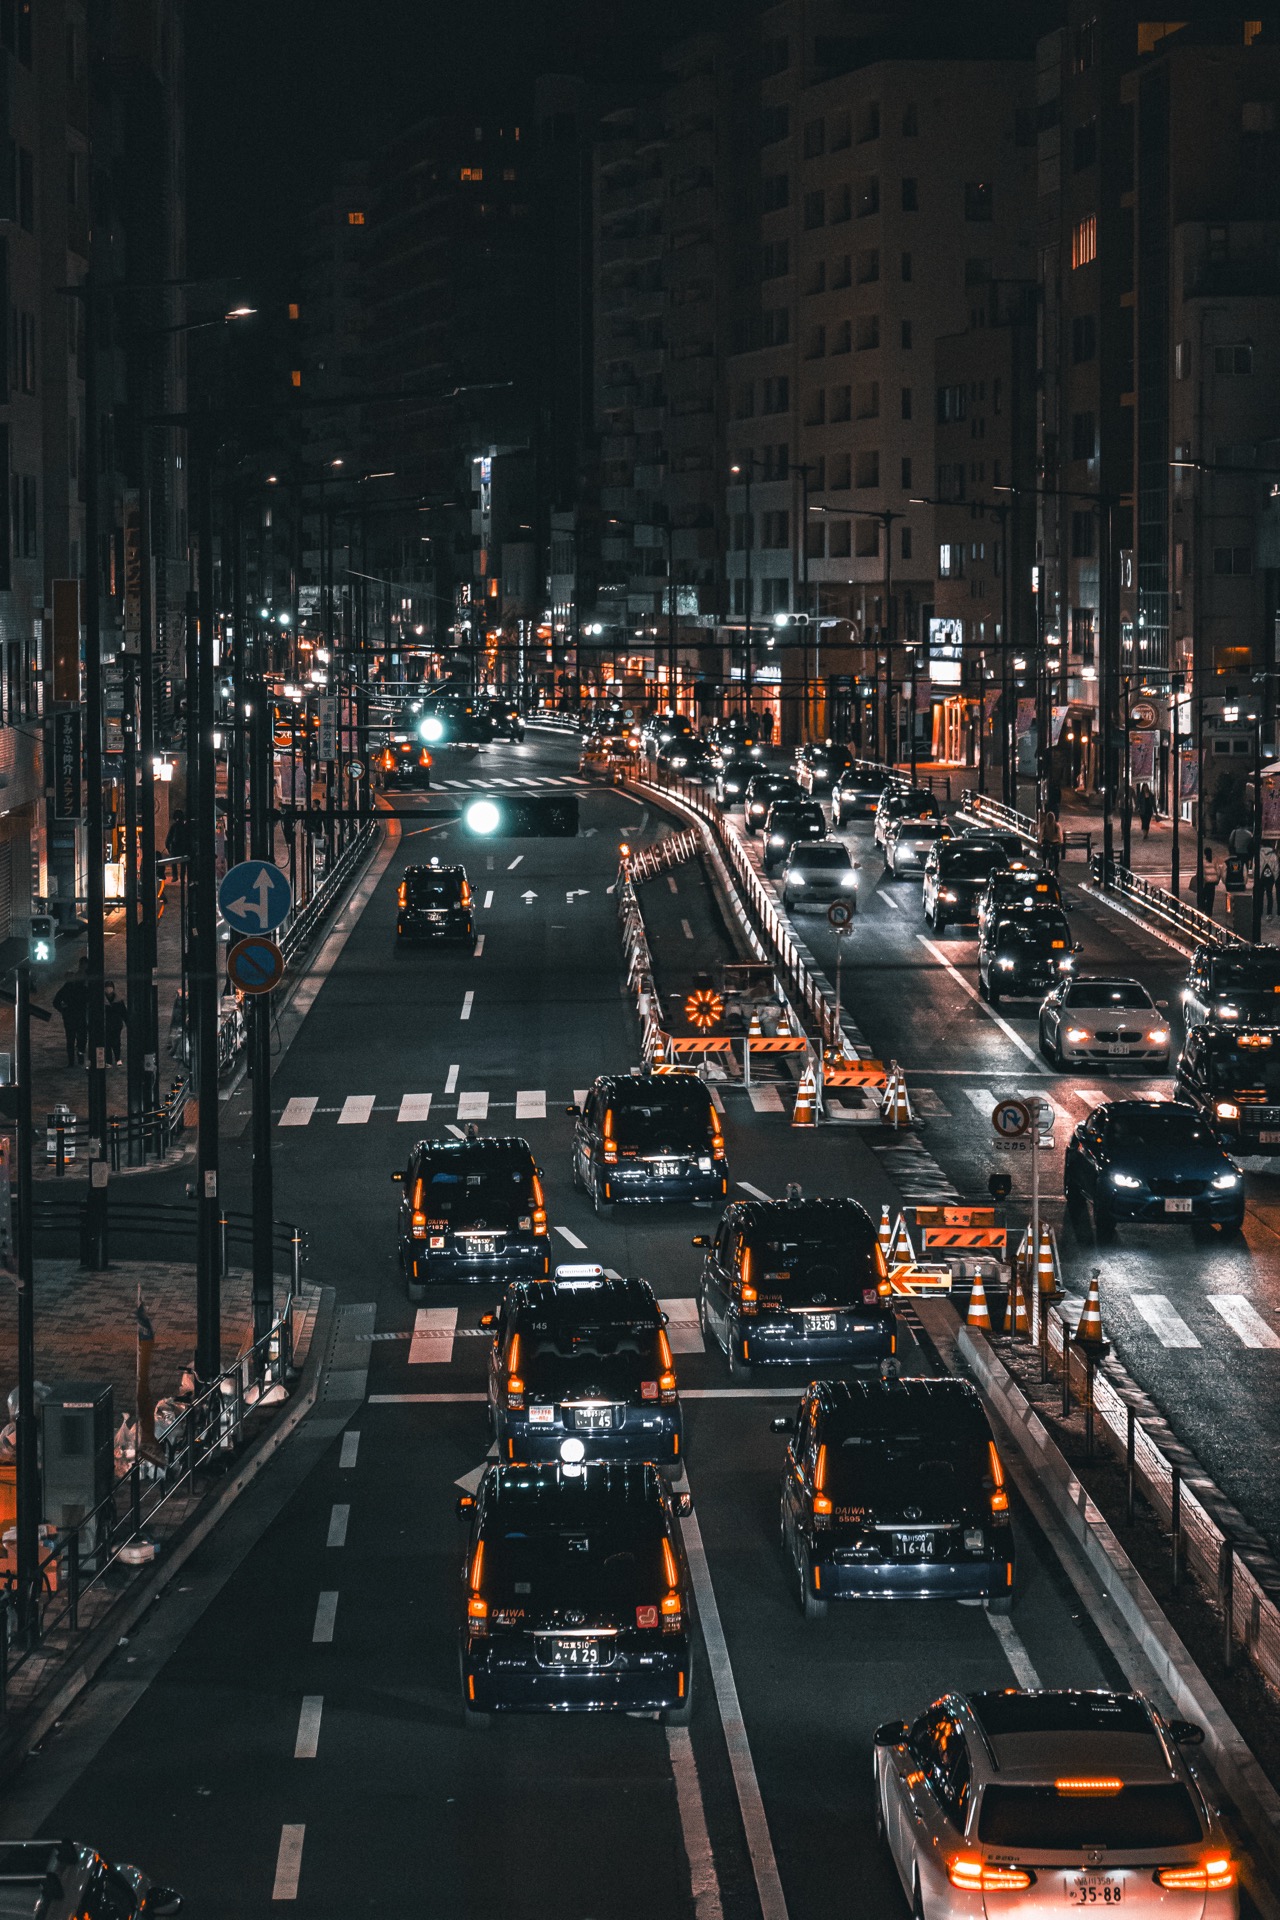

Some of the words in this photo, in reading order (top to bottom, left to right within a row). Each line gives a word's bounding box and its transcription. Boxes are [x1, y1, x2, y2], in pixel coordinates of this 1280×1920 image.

[63, 714, 73, 816] すみふの仲介ステップ
[996, 1142, 1026, 1150] ここから
[531, 1322, 548, 1331] 145
[811, 1320, 836, 1331] 32-09
[835, 1507, 865, 1515] DAIWA
[902, 1542, 933, 1554] 16-44
[491, 1608, 525, 1618] DAIWA
[1079, 1886, 1121, 1902] 35-88
